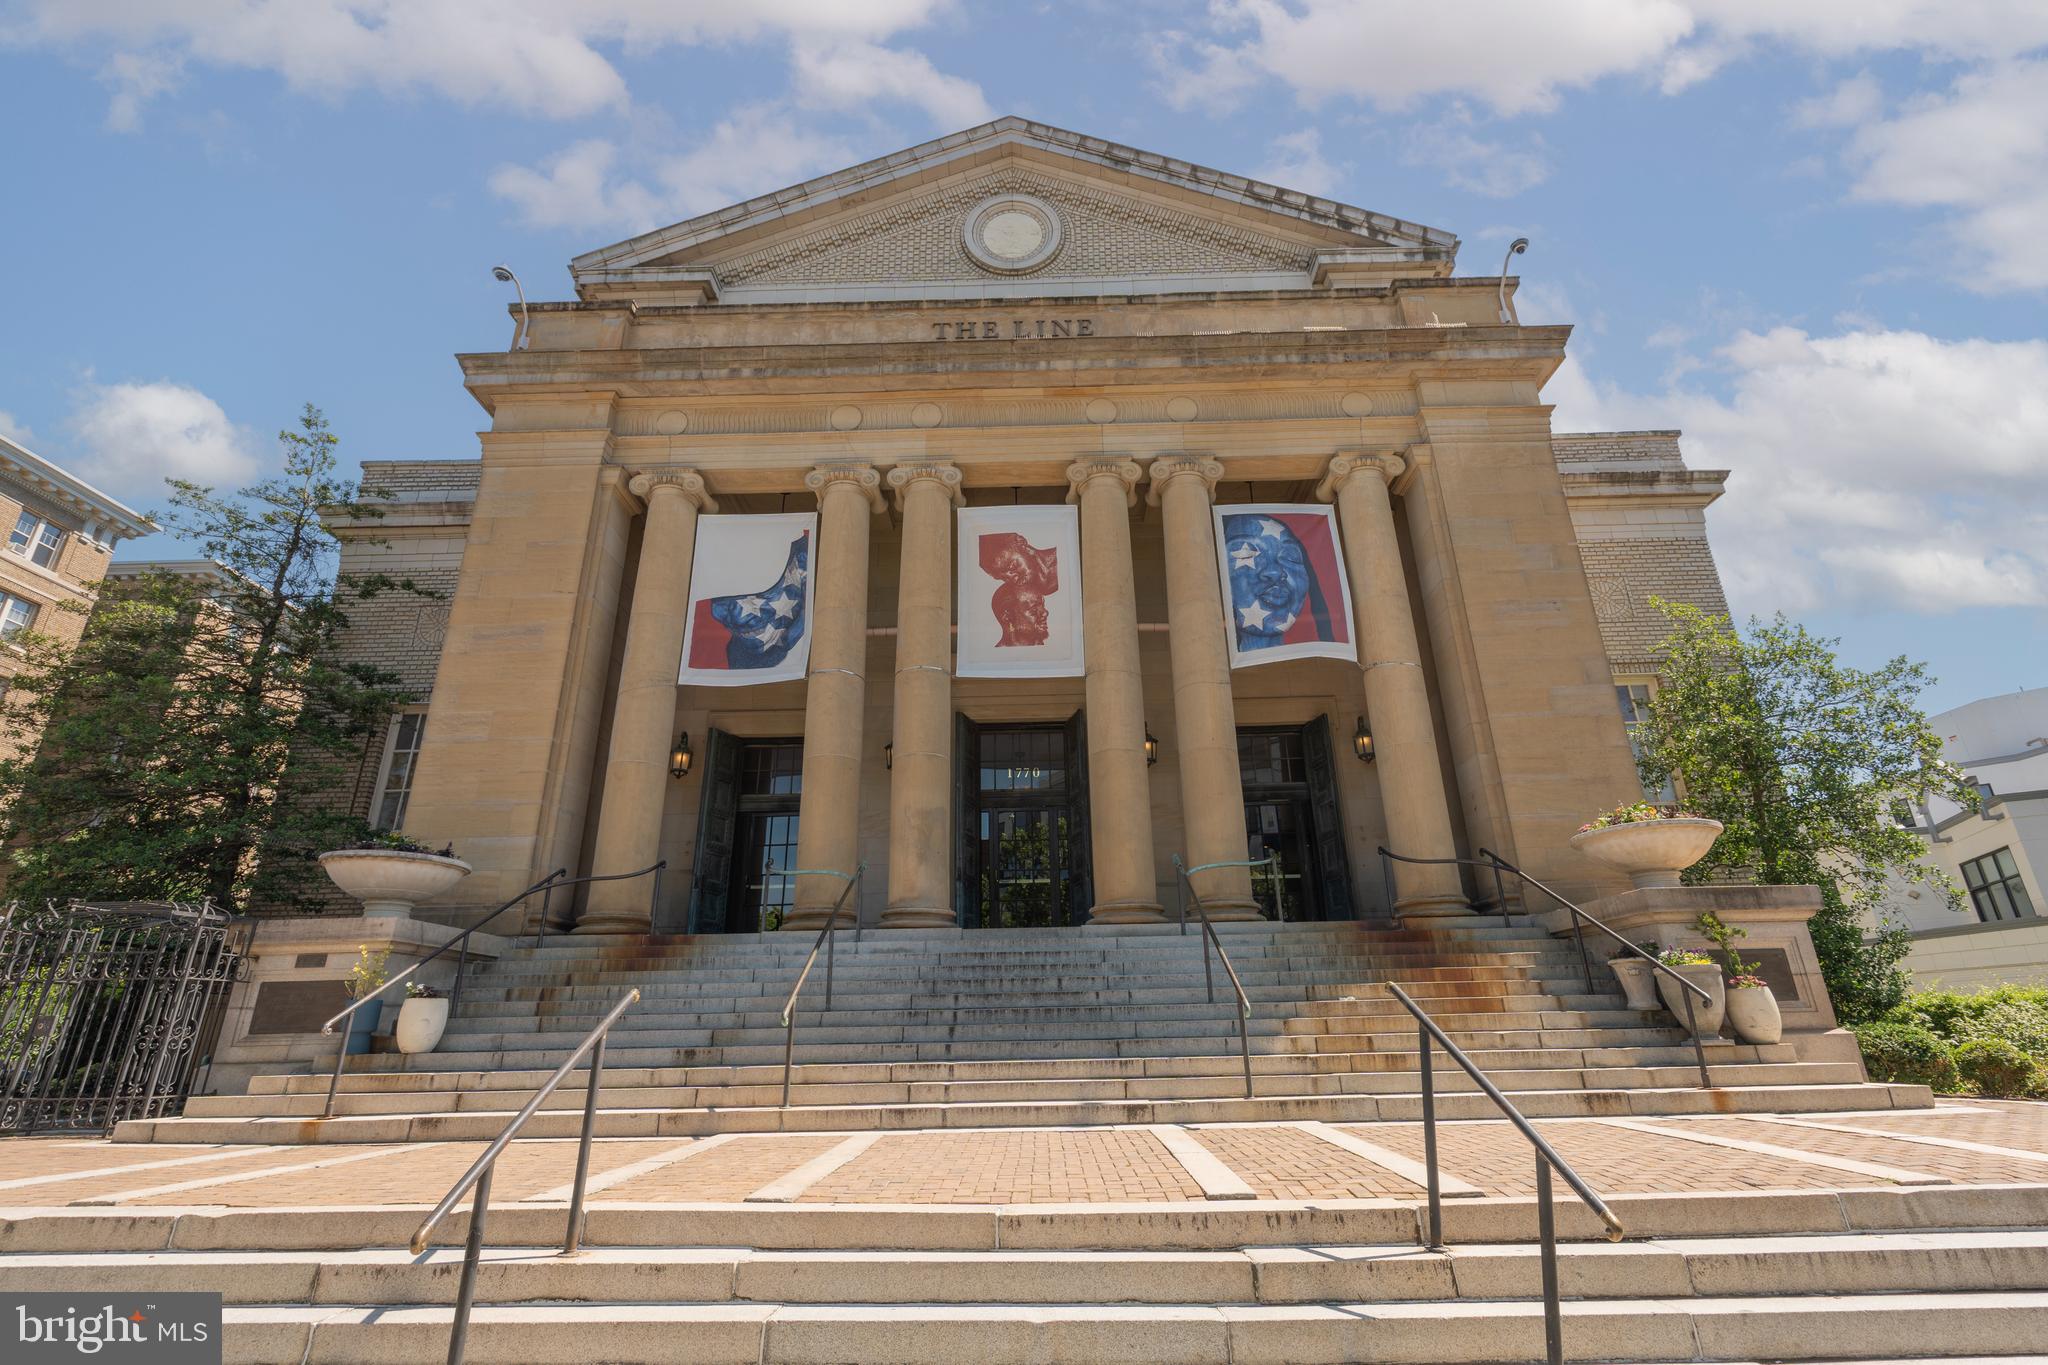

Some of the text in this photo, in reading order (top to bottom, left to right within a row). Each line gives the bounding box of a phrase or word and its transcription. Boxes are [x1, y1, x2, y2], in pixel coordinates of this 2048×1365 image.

[932, 319, 1095, 340] THE LINE
[1008, 767, 1040, 778] 1770
